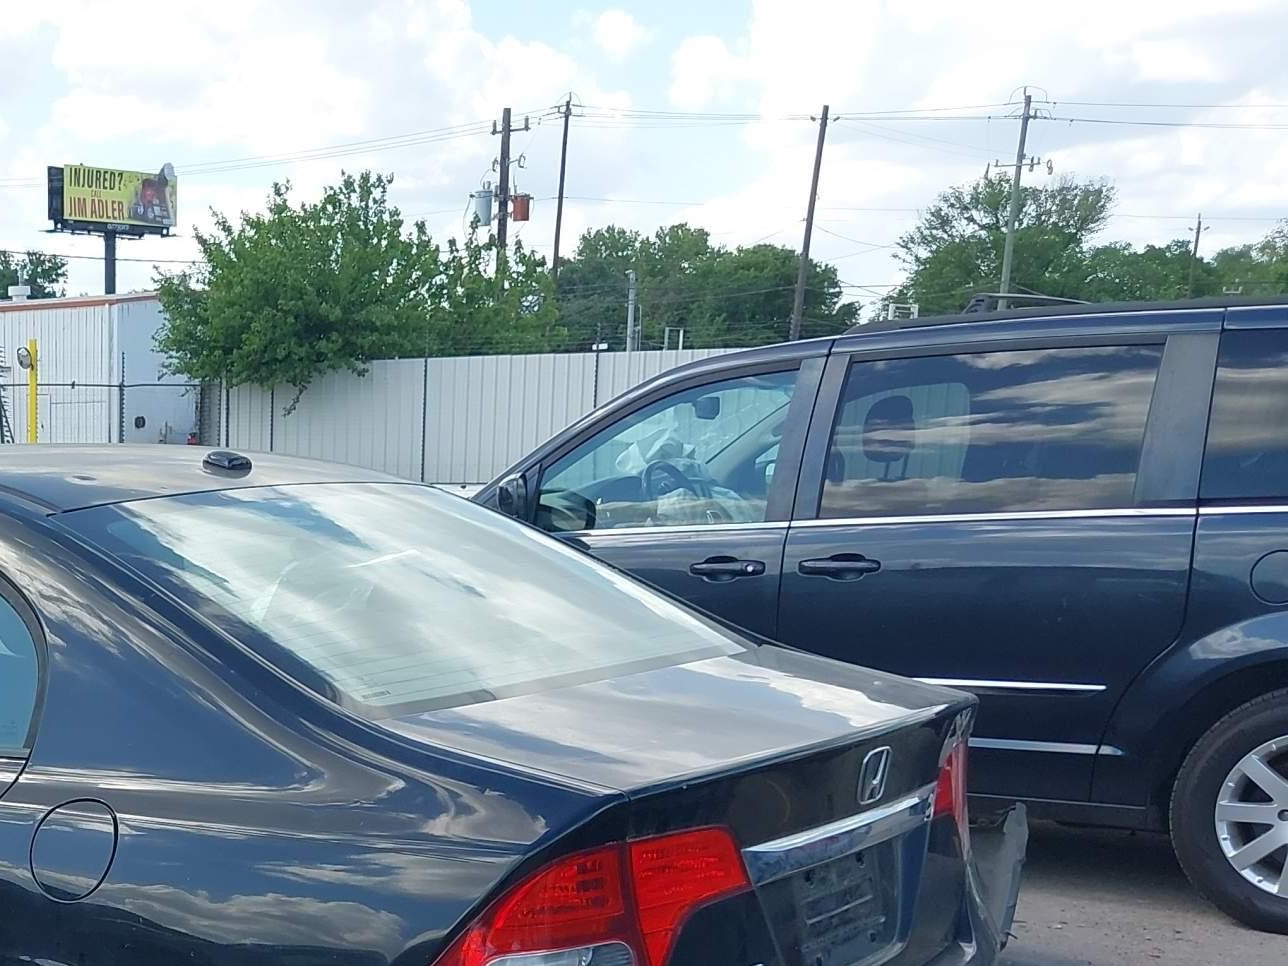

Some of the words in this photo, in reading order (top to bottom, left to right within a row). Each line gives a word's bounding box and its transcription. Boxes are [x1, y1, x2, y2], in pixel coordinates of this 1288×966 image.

[69, 167, 123, 191] INJURED?
[69, 197, 87, 218] JIM
[91, 199, 125, 221] ADLER
